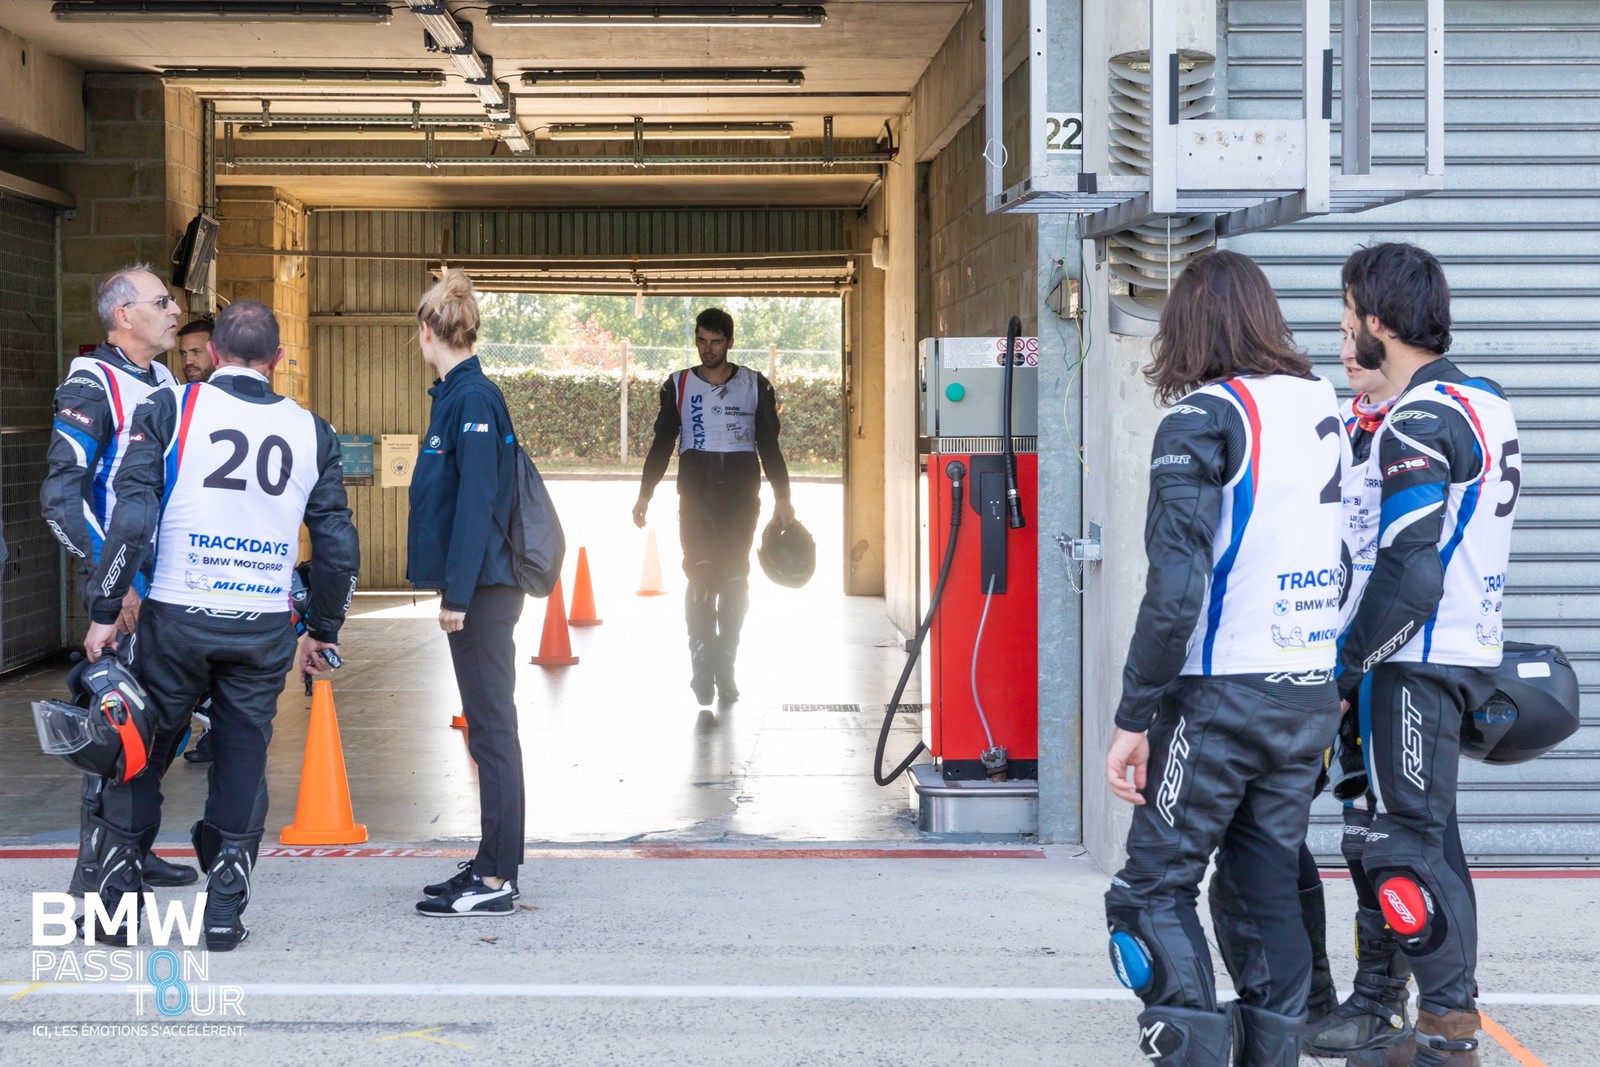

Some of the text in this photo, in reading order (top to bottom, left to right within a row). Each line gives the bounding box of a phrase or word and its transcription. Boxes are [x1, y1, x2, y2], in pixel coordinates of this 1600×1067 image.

[1046, 117, 1083, 150] 22
[202, 428, 294, 497] 20
[1386, 458, 1426, 476] R-16
[1494, 437, 1521, 518] 5
[188, 533, 290, 557] TRACKDAYS
[101, 542, 127, 598] RST
[202, 556, 283, 572] BMW MOTORRAD
[212, 580, 284, 595] MICHELIN
[1295, 599, 1324, 612] BMW
[1362, 619, 1415, 673] RST
[1402, 686, 1425, 791] RST
[1156, 714, 1191, 828] RST
[1383, 889, 1417, 926] RST
